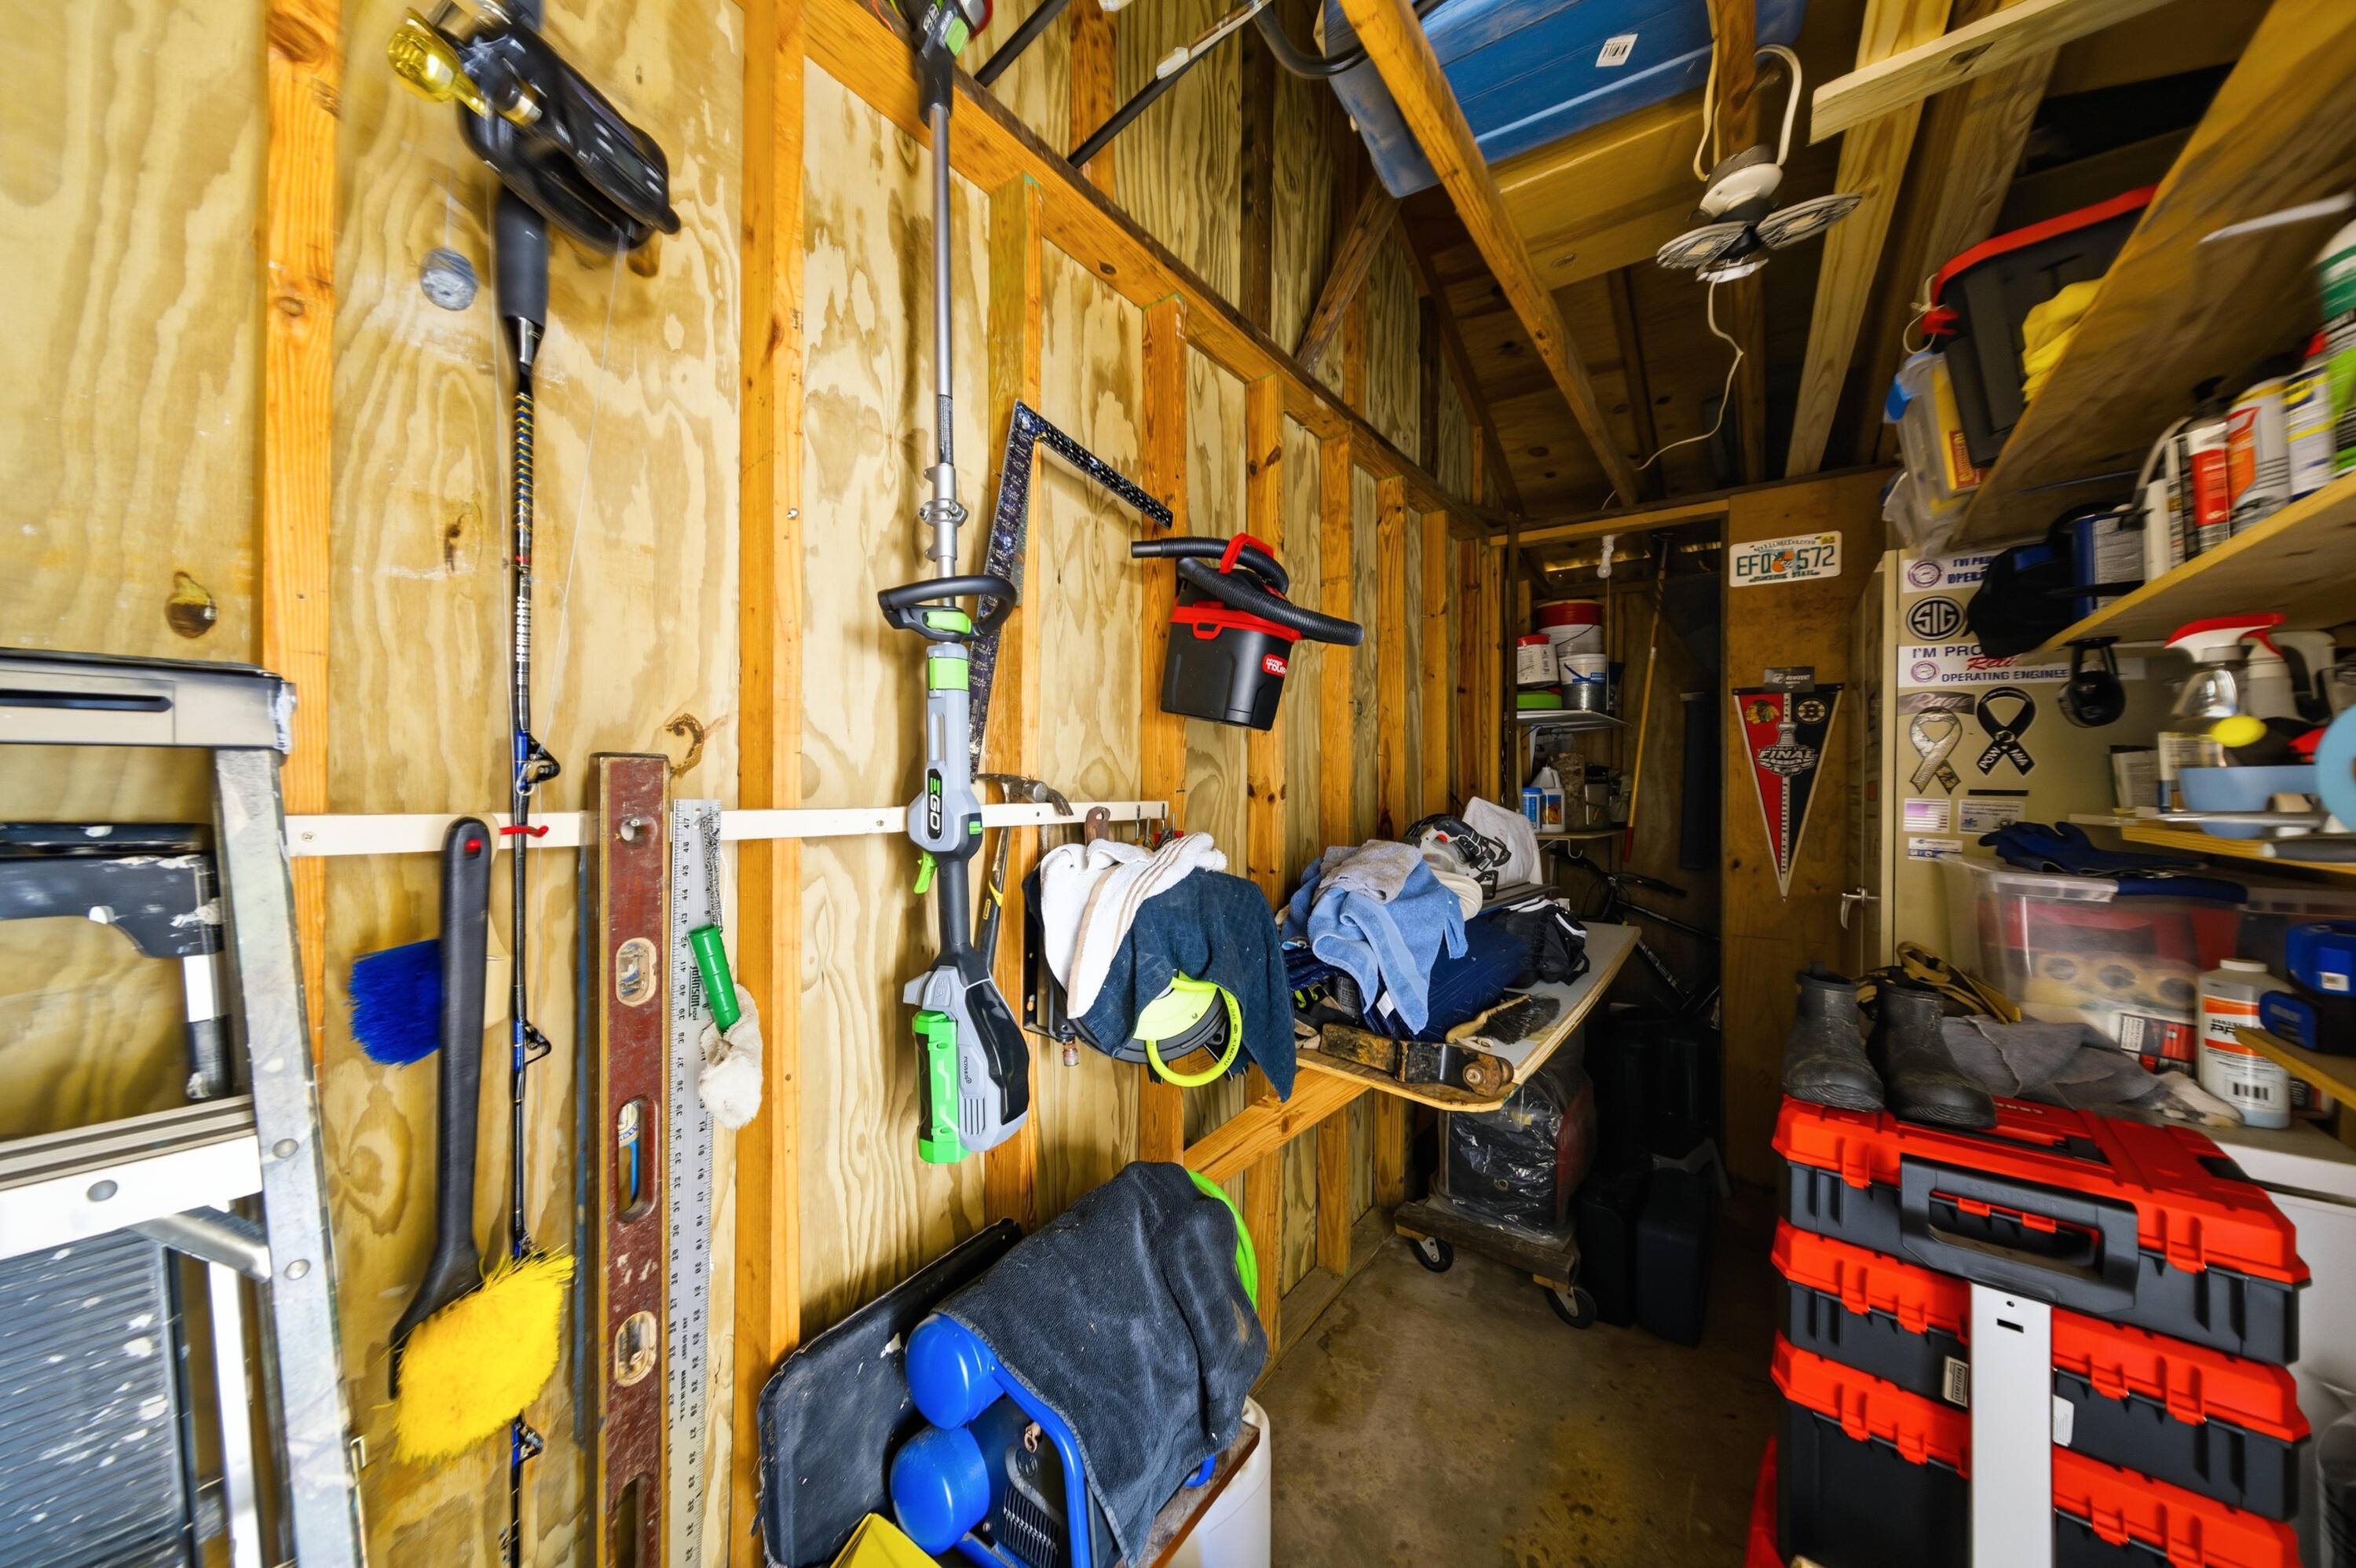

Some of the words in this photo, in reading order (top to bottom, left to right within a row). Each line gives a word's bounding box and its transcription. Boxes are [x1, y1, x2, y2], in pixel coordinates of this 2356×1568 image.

[1913, 600, 1958, 635] SIG
[1912, 646, 1937, 659] I'M
[1941, 671, 2010, 683] OPERATING
[2014, 668, 2069, 680] ENGINEE
[1759, 750, 1816, 759] FINAL
[1978, 747, 2002, 769] POW
[2009, 748, 2029, 767] MIA
[930, 777, 941, 831] EGO
